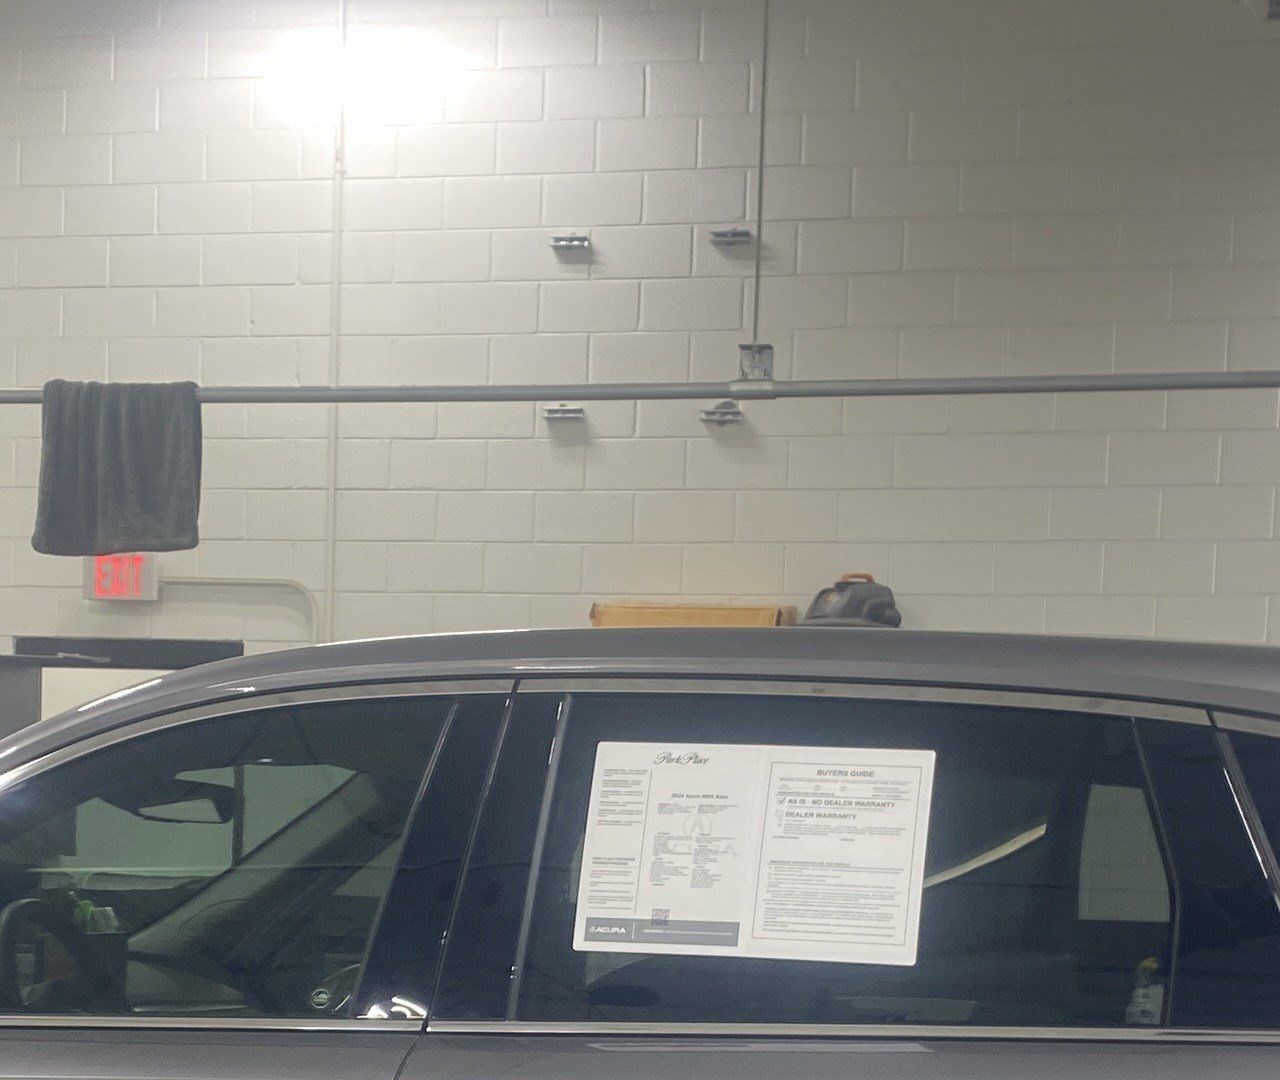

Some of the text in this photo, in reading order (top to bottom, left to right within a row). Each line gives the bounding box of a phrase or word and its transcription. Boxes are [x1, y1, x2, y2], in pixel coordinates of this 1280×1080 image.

[95, 554, 144, 597] EXIT
[654, 751, 710, 766] Park Place
[816, 769, 875, 778] BUYERS GUIDE
[824, 799, 853, 807] DEALER
[855, 800, 896, 808] WARRANTY
